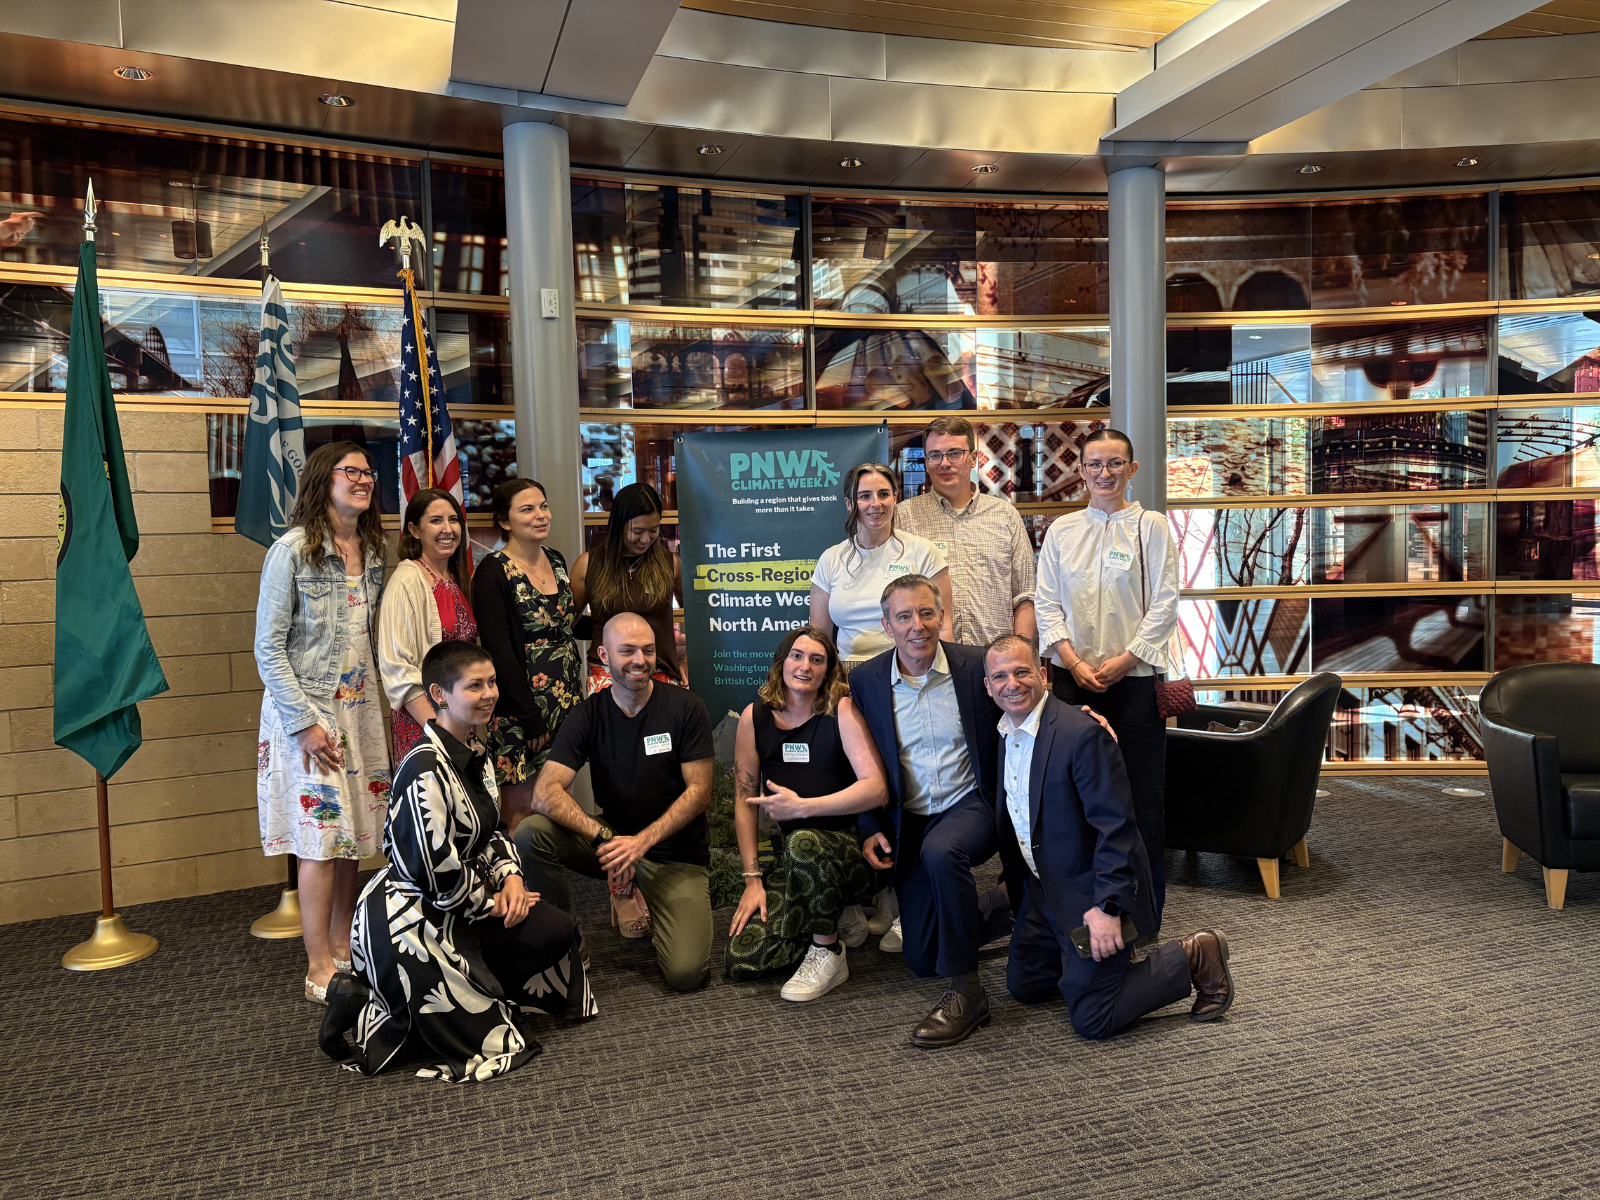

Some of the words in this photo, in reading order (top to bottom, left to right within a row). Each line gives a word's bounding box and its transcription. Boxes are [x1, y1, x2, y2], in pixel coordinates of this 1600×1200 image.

[730, 449, 811, 480] PNW
[731, 479, 785, 491] CLIMATE
[787, 477, 823, 489] WEEK
[732, 497, 760, 505] Building
[765, 496, 787, 505] region
[802, 495, 820, 504] gives
[704, 543, 737, 558] The
[740, 542, 781, 558] First
[708, 592, 772, 607] Climate
[775, 591, 811, 607] Wee
[709, 617, 757, 632] North
[760, 616, 811, 632] Amer
[712, 650, 731, 659] Join
[732, 650, 748, 659] the
[750, 651, 775, 659] move
[713, 663, 769, 674] Washington
[714, 676, 745, 686] British
[746, 676, 767, 686] Colu
